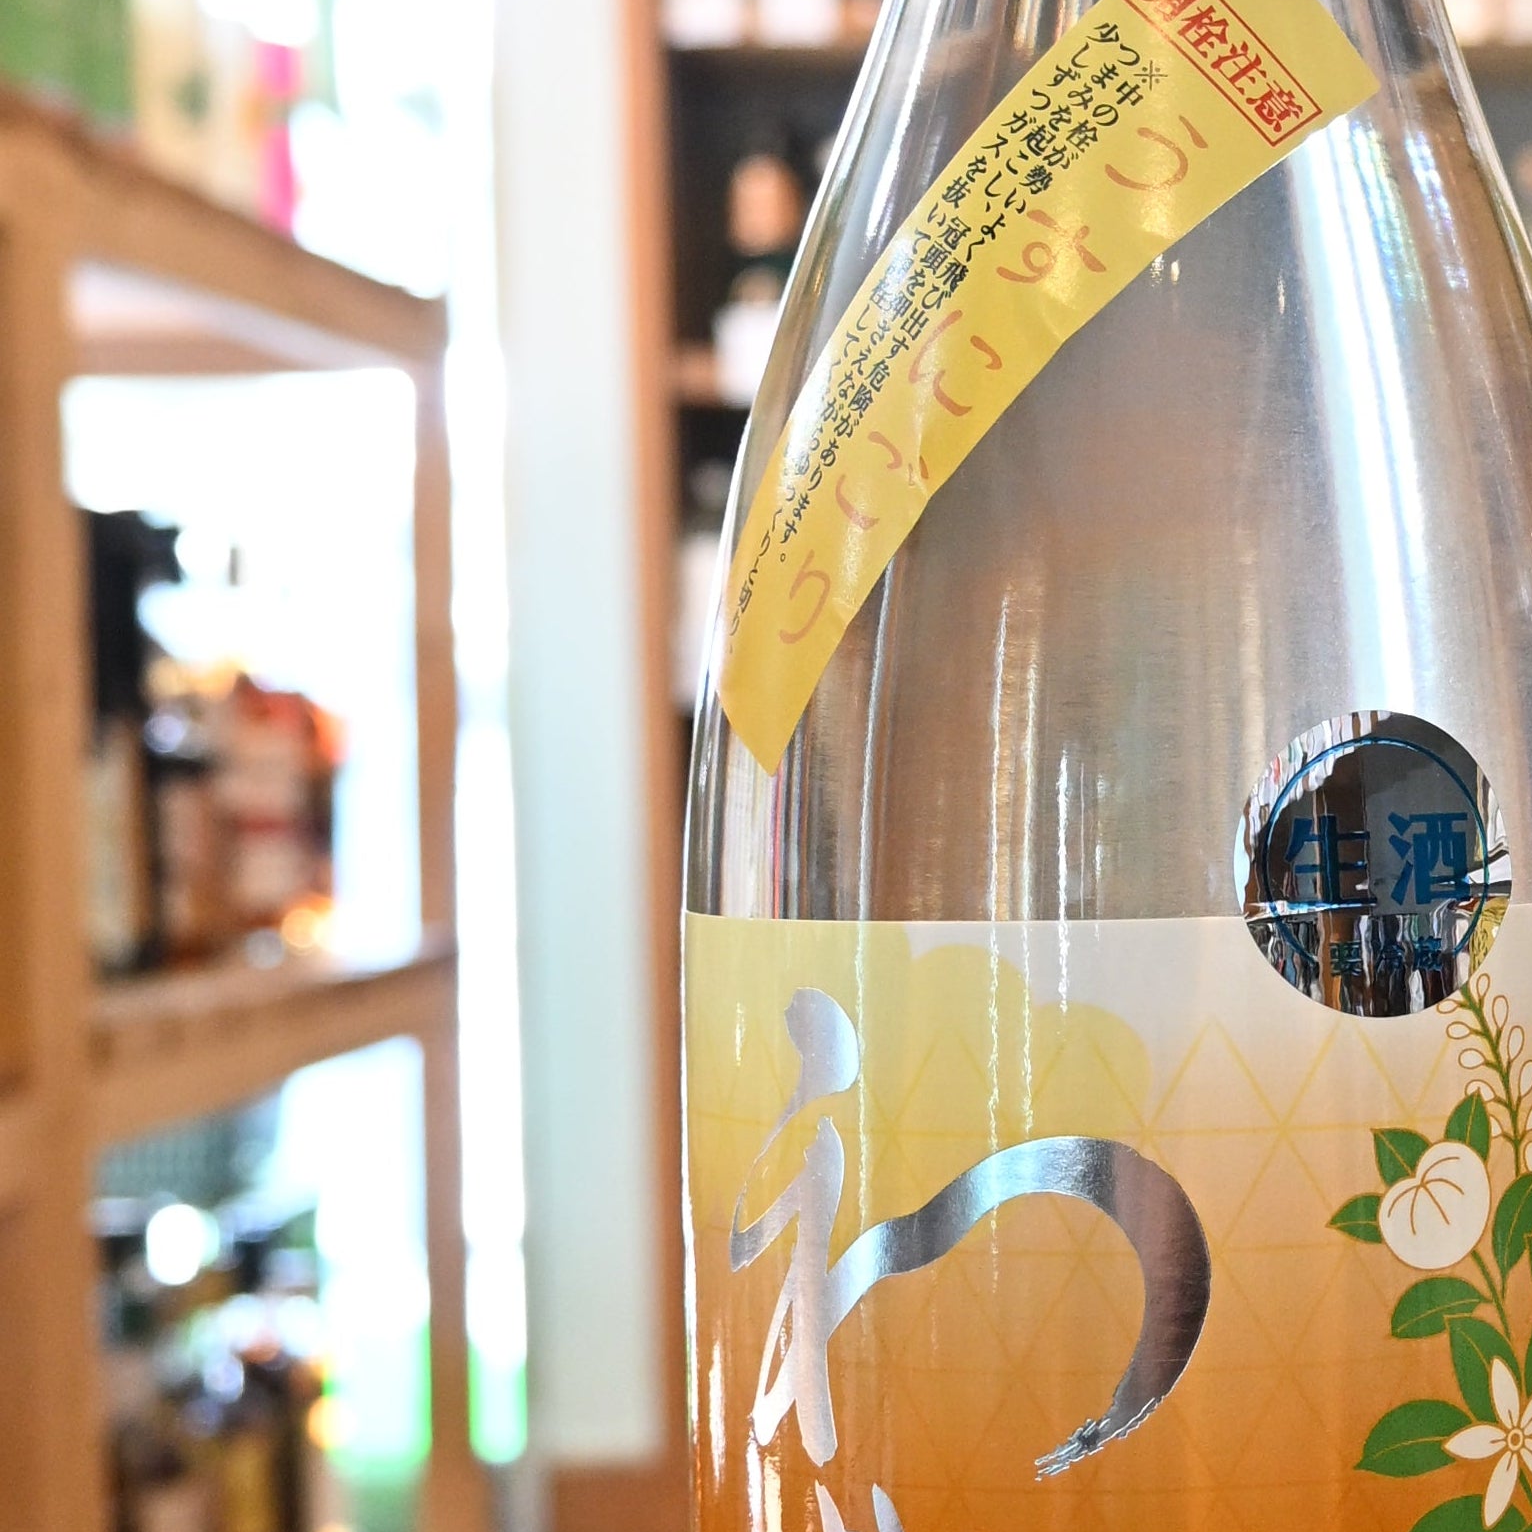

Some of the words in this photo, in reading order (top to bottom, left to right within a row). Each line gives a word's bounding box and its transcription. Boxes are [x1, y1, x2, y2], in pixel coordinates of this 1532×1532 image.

[778, 115, 1209, 645] うすにごり
[1274, 810, 1471, 911] 生酒
